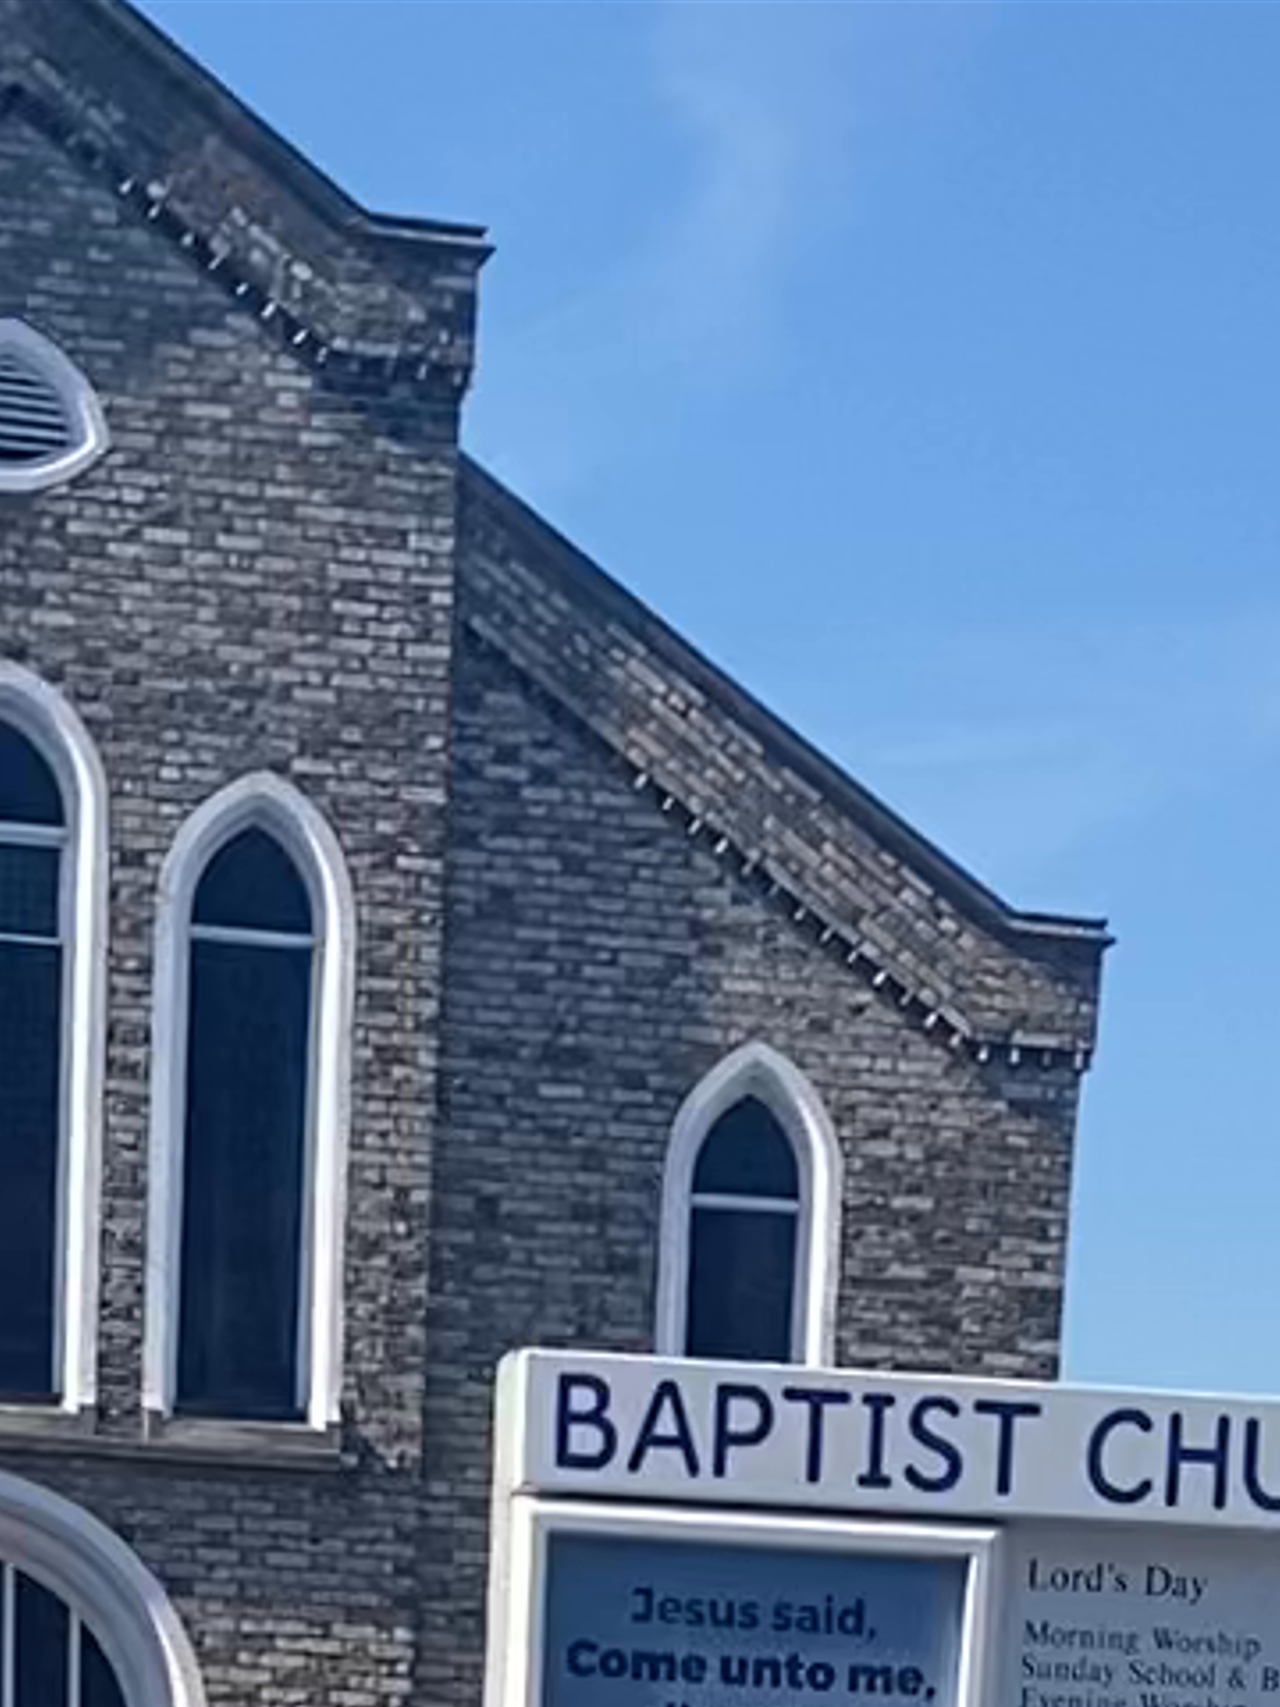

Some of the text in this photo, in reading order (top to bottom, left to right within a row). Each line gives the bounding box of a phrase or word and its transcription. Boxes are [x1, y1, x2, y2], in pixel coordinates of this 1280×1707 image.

[553, 1371, 1042, 1498] BAPTIST
[1028, 1557, 1208, 1606] Lord's Day
[631, 1587, 876, 1640] Jesus said,
[1024, 1620, 1140, 1655] Morning
[1153, 1627, 1262, 1662] Worship
[567, 1639, 936, 1701] Come unto me,
[1021, 1654, 1113, 1687] Sunday
[1128, 1659, 1216, 1688] School
[1228, 1666, 1247, 1690] &
